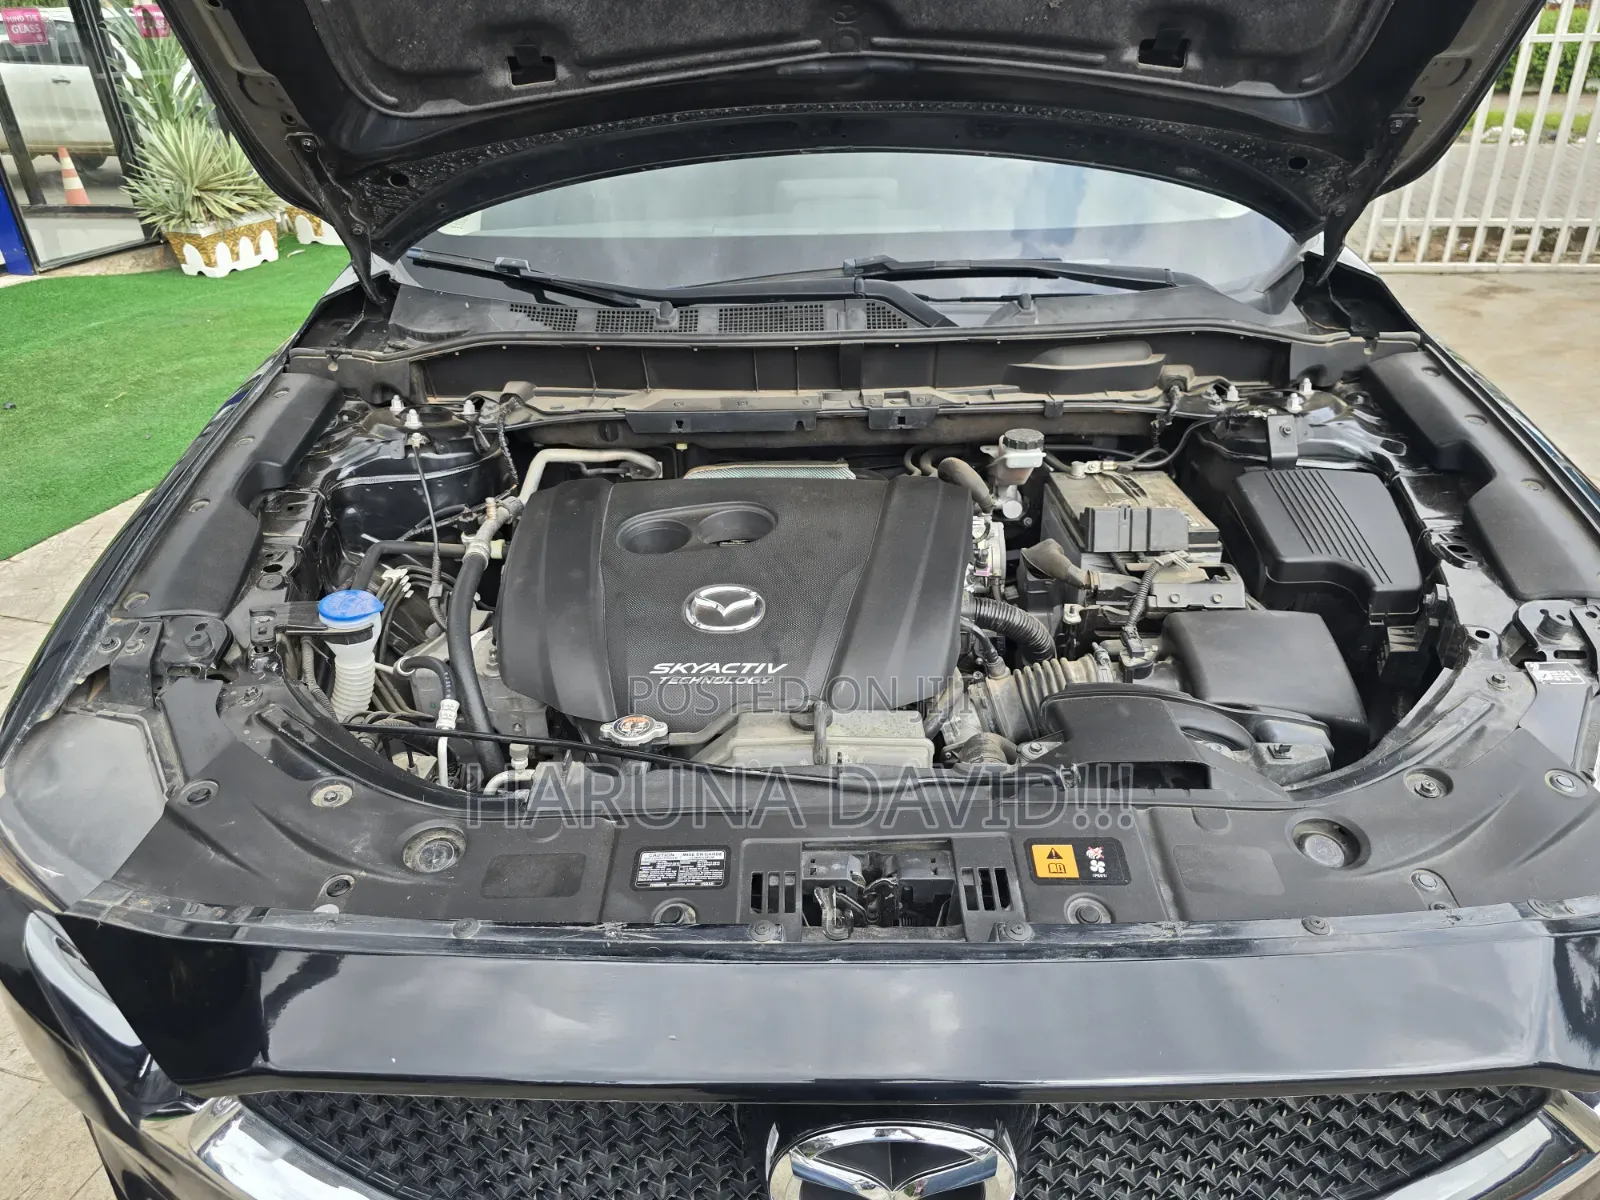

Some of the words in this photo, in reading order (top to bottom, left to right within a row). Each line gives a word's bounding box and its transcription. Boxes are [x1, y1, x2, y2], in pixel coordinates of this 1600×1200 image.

[7, 15, 25, 23] MIND
[26, 14, 39, 22] THE
[11, 24, 41, 35] GLASS
[649, 662, 788, 674] SKYACTIV
[660, 676, 773, 685] TECHNOLOGY
